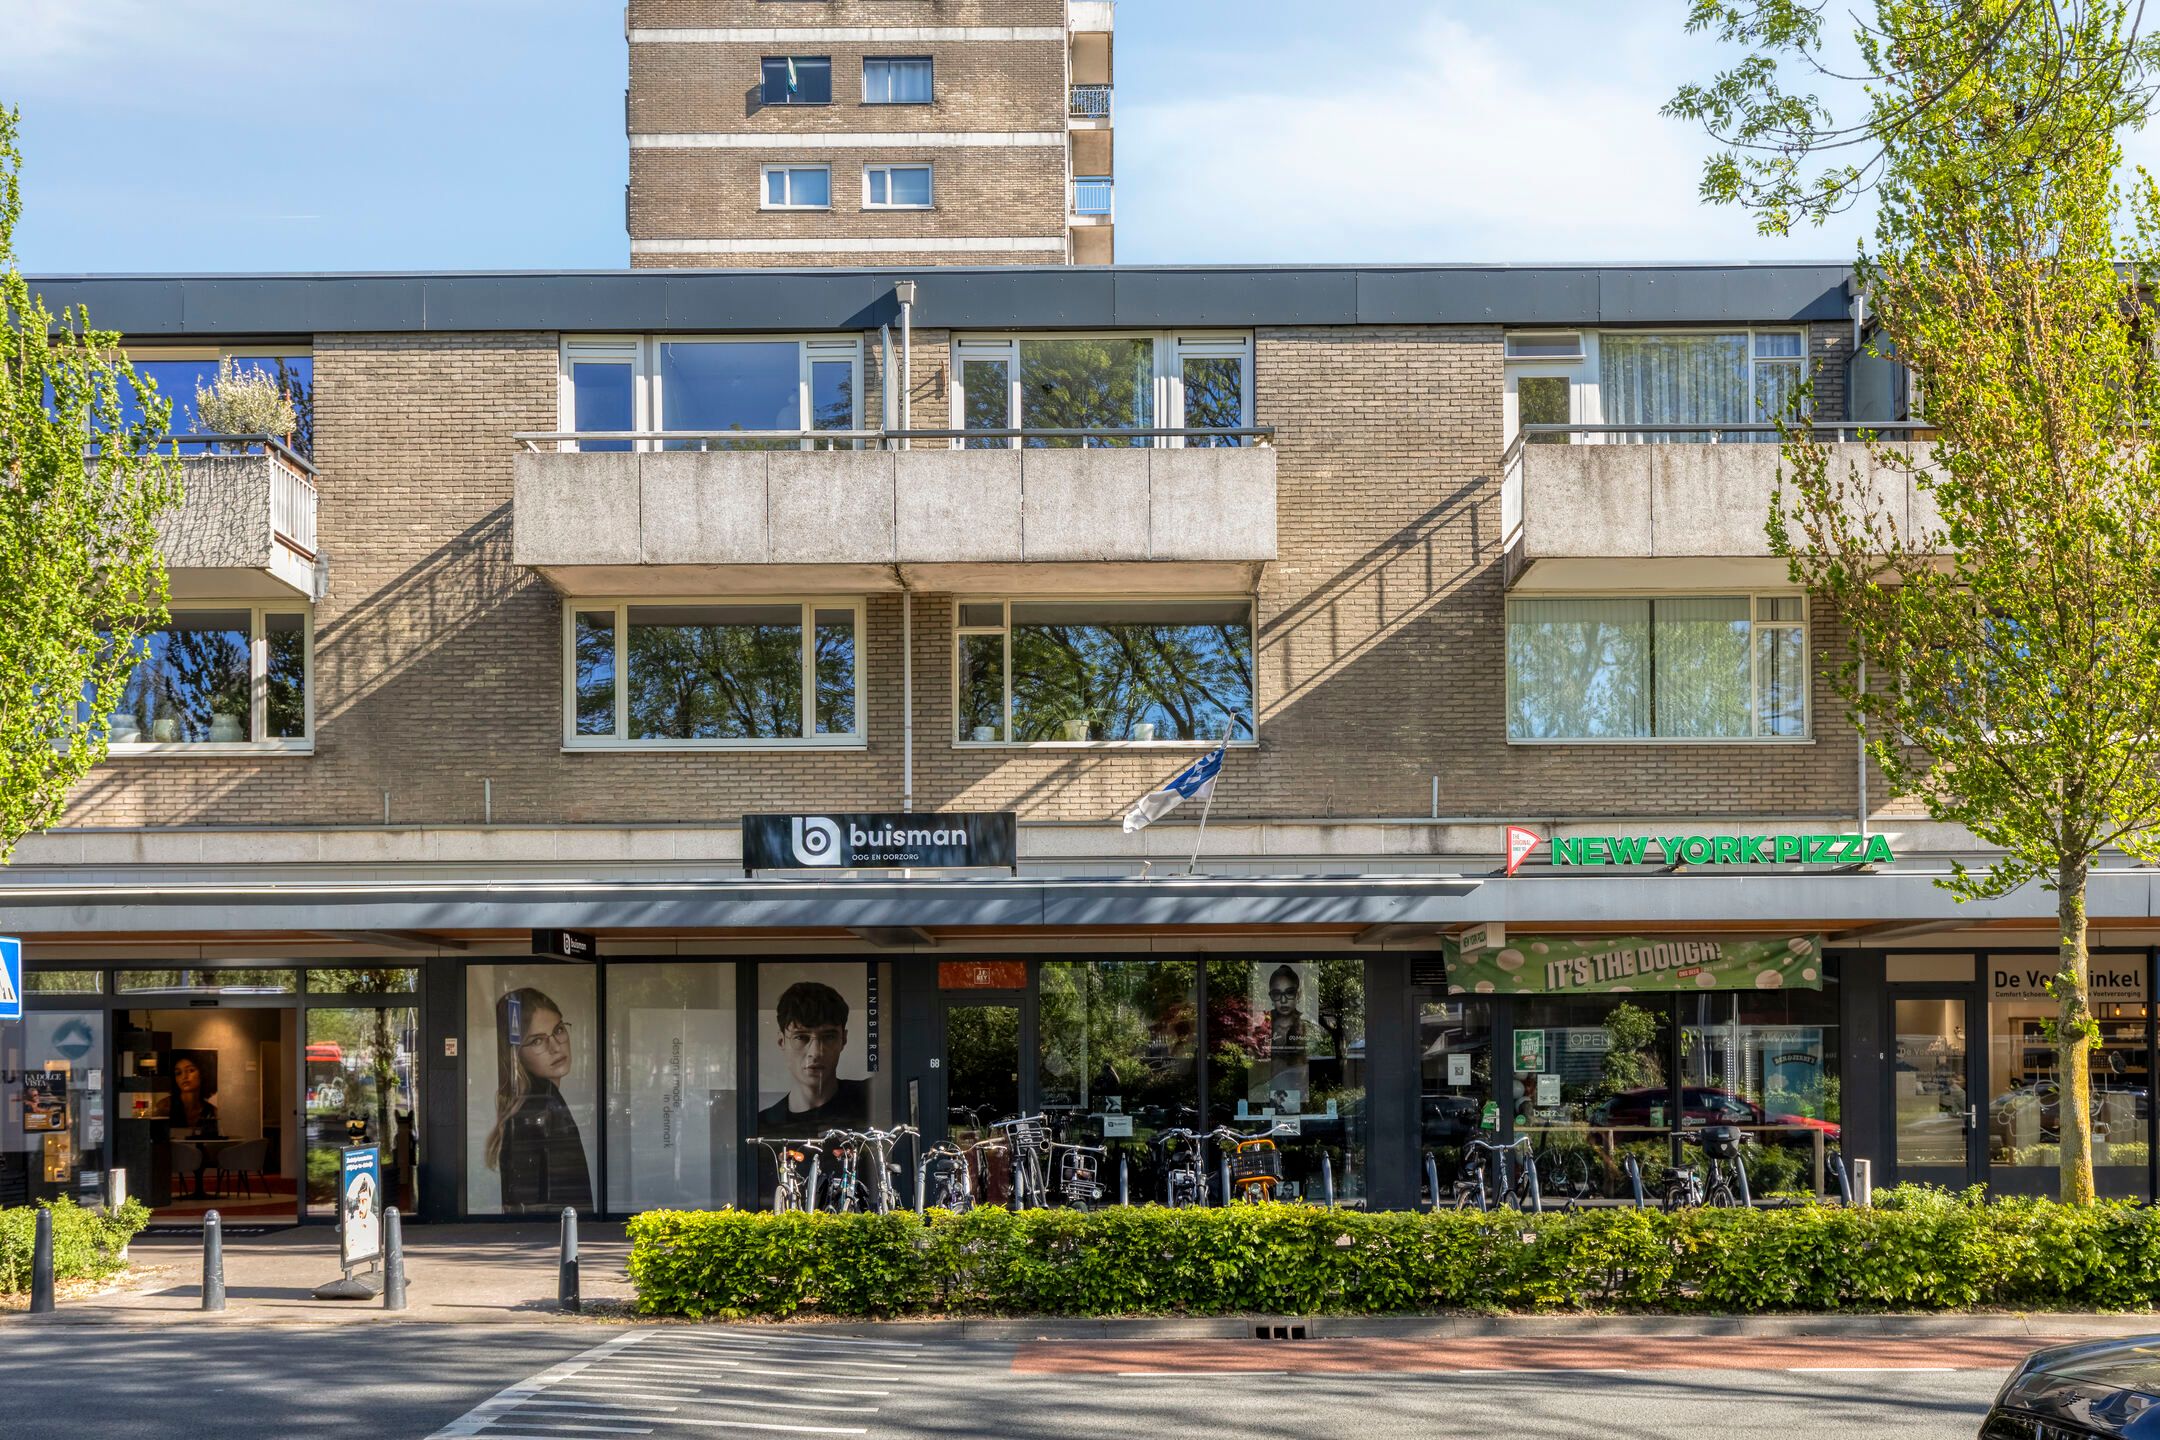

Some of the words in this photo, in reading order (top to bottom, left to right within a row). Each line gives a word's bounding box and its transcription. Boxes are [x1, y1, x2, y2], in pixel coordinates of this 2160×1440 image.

[850, 824, 967, 847] buisman
[883, 853, 919, 861] OORZORG
[1551, 836, 1648, 866] NEW
[1656, 835, 1770, 865] YORK
[1774, 834, 1896, 863] PIZZA
[1546, 956, 1589, 990] IT'S
[1592, 950, 1635, 981] THE
[1637, 942, 1723, 973] DOUGH!
[1994, 971, 2020, 988] De
[2026, 970, 2141, 988] Voinkel
[868, 977, 877, 1062] LINDBERG
[1571, 1034, 1610, 1046] OPEN
[669, 1037, 683, 1070] design
[930, 1058, 940, 1068] 68
[36, 1073, 62, 1081] DOLCE
[663, 1094, 671, 1103] in
[672, 1080, 683, 1108] made
[663, 1105, 674, 1148] denmark
